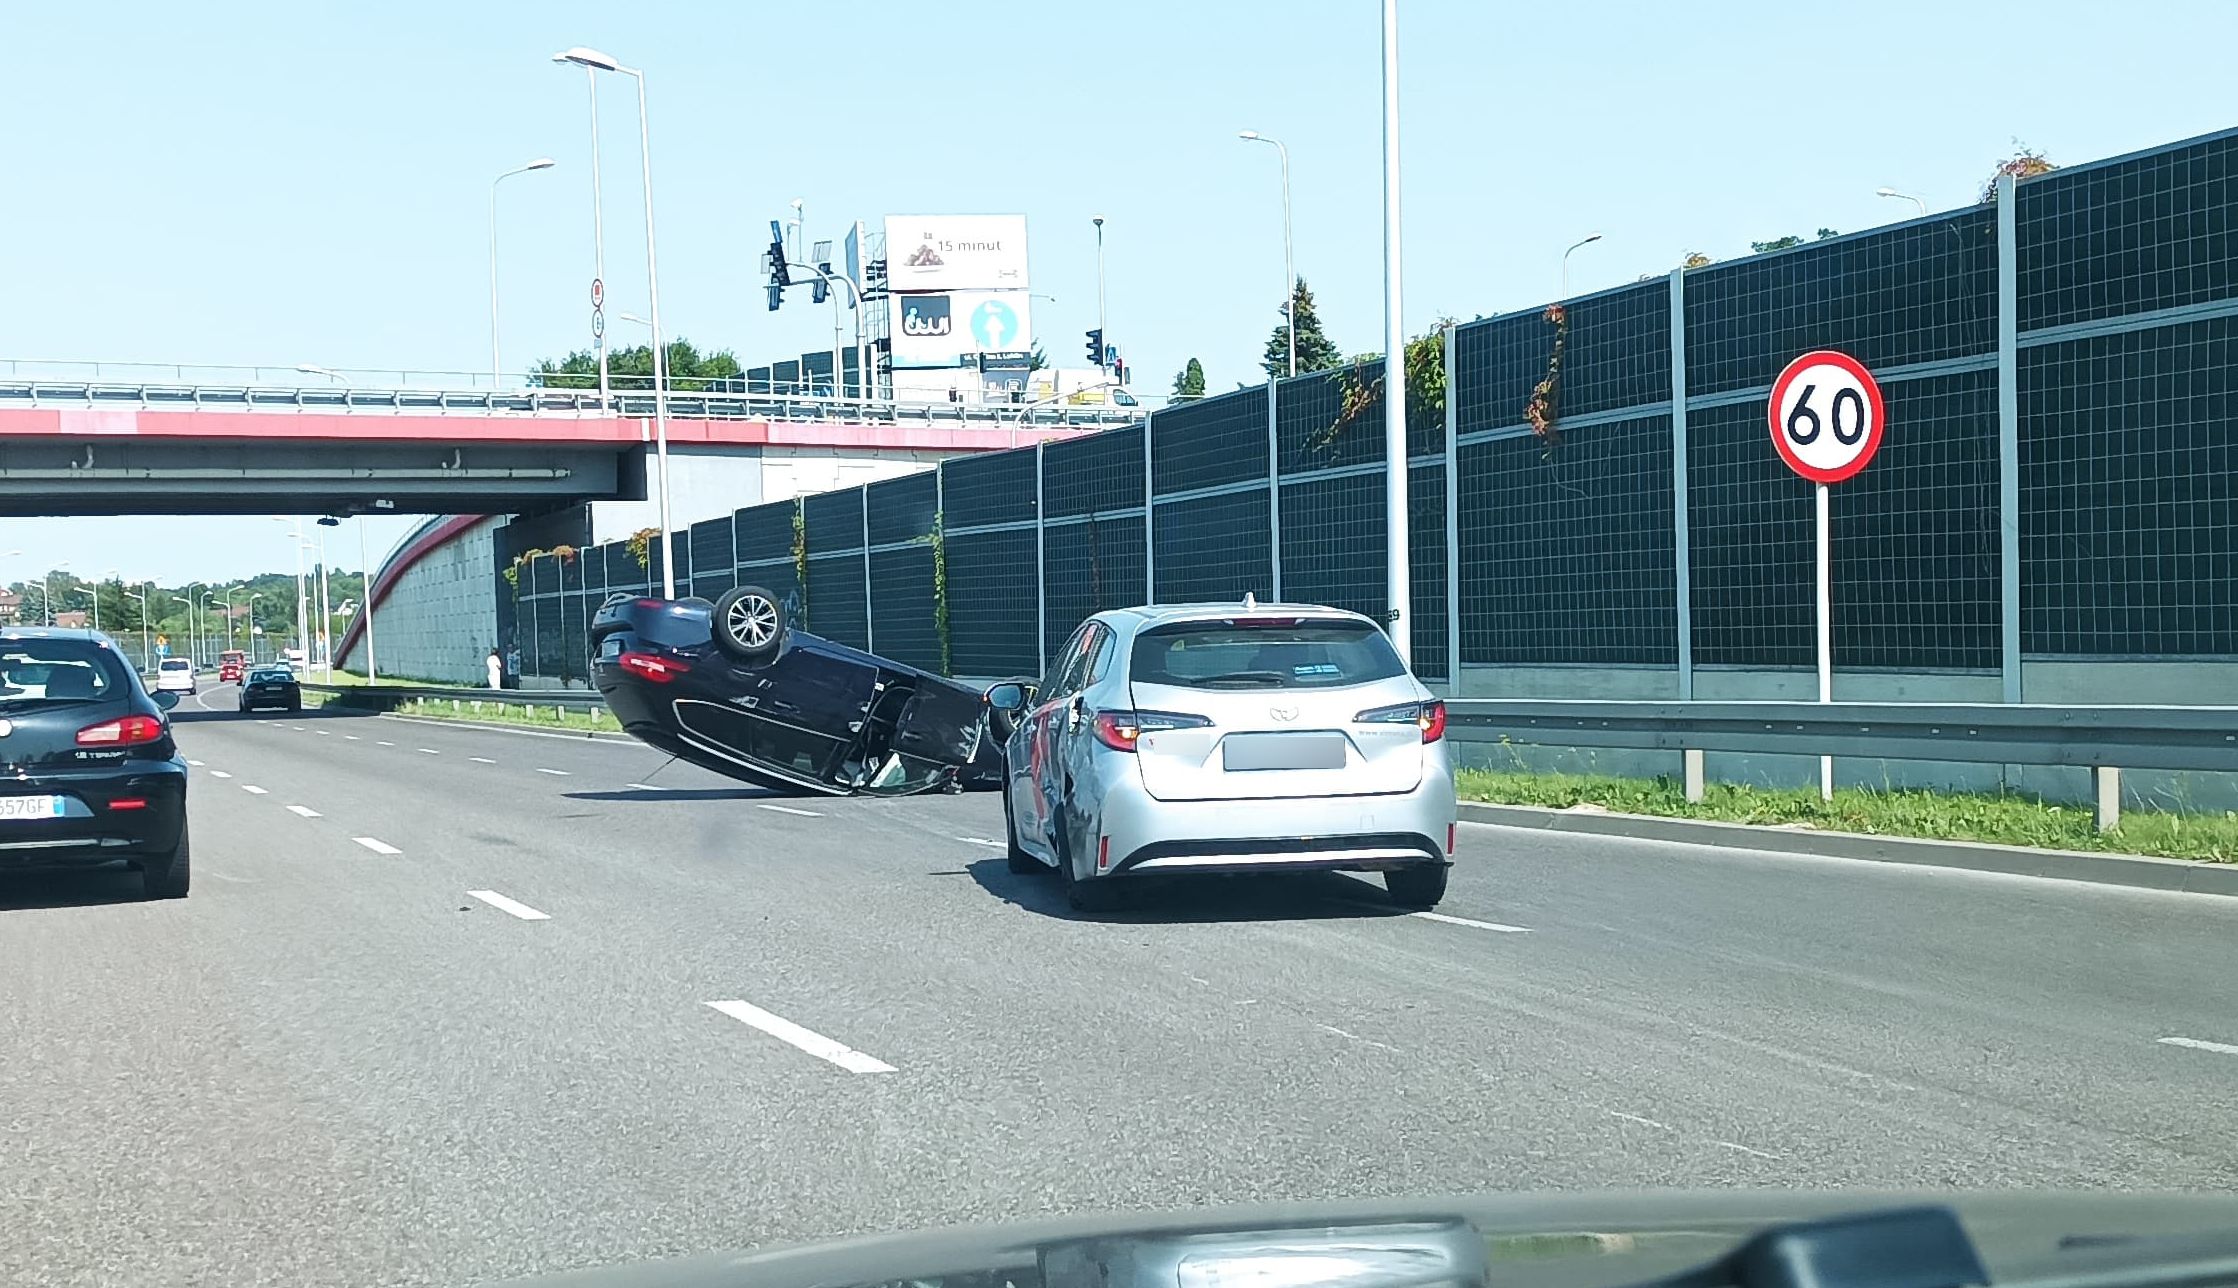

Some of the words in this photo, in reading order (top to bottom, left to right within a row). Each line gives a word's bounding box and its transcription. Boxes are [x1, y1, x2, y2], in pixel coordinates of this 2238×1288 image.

[938, 240, 953, 252] 15
[958, 240, 1002, 251] minut
[1787, 384, 1865, 446] 60
